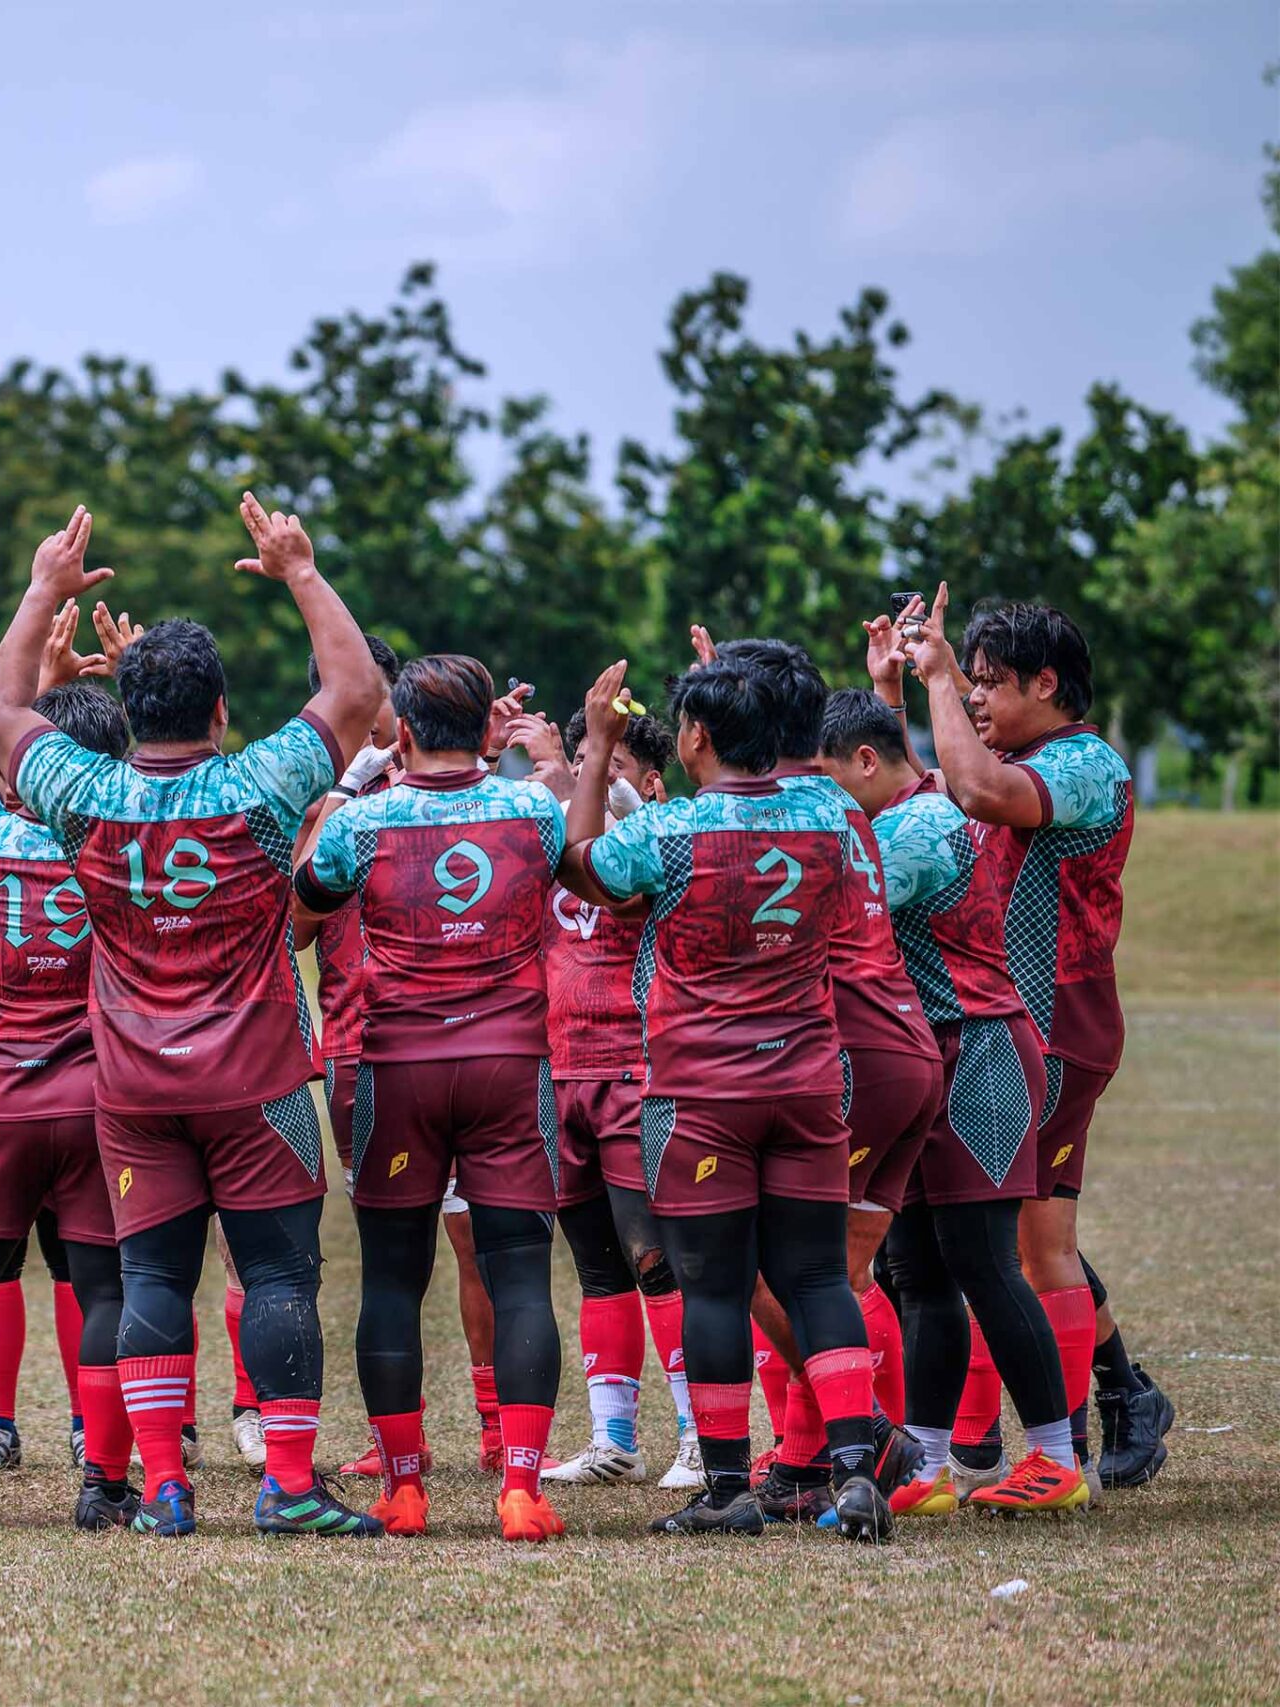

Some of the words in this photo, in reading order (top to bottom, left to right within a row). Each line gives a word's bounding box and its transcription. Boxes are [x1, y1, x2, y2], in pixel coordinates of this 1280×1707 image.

[452, 800, 482, 812] iPDP
[848, 823, 880, 895] 4
[118, 838, 217, 910] 18
[433, 839, 494, 916] 9
[750, 847, 803, 926] 2
[153, 916, 192, 926] PITA
[441, 922, 485, 932] PITA
[756, 933, 793, 942] PITA
[26, 956, 68, 966] PITA
[396, 1456, 418, 1474] FS
[509, 1448, 536, 1468] FS
